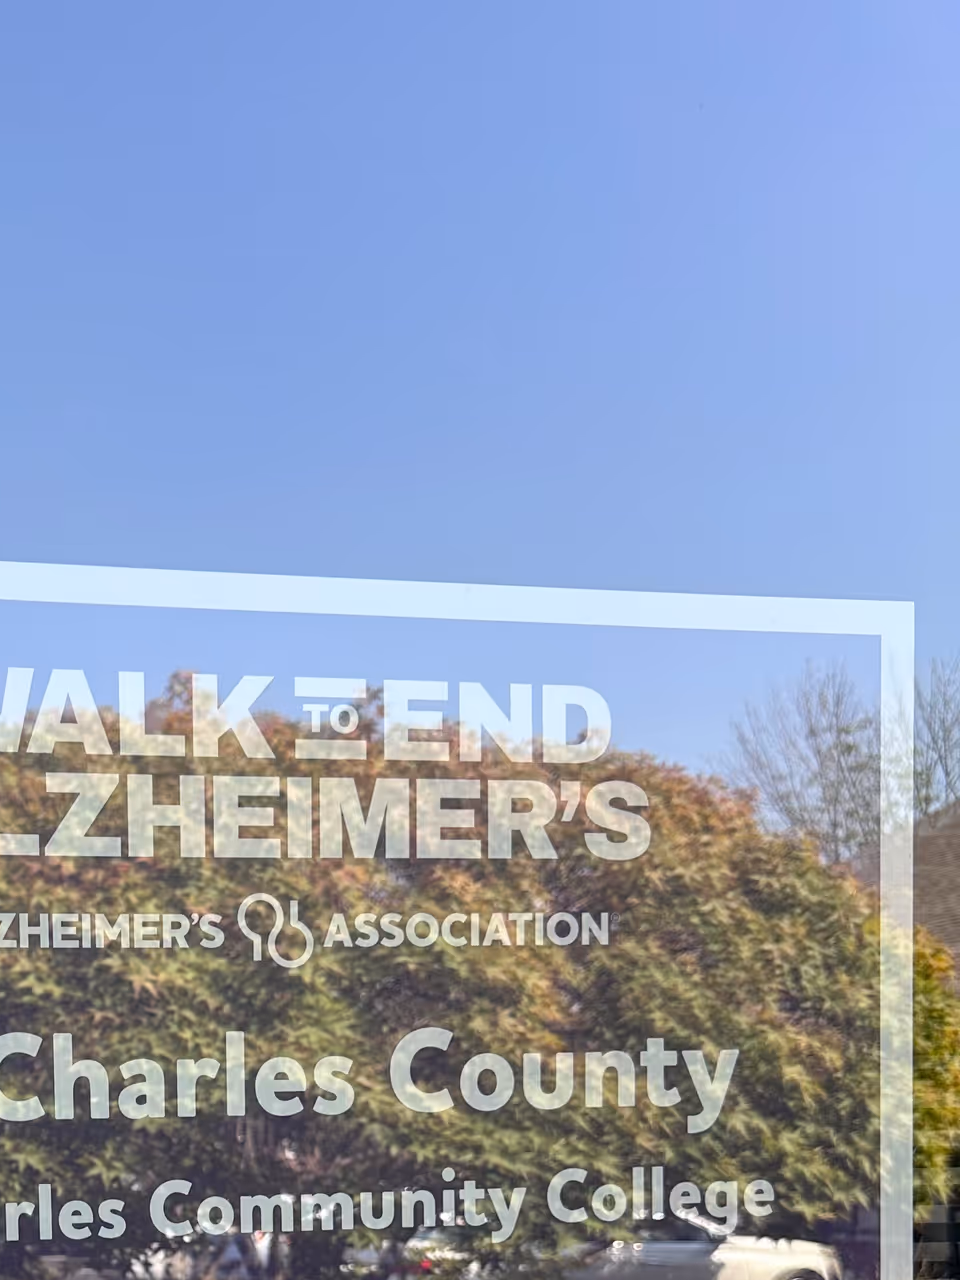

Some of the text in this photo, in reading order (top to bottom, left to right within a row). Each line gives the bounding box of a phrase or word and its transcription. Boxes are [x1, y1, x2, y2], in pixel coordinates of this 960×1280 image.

[302, 703, 359, 734] TO
[383, 679, 612, 763] END
[323, 911, 610, 948] ASSOCIATION
[389, 1026, 739, 1134] County
[149, 1167, 527, 1244] Community
[546, 1165, 775, 1236] College
